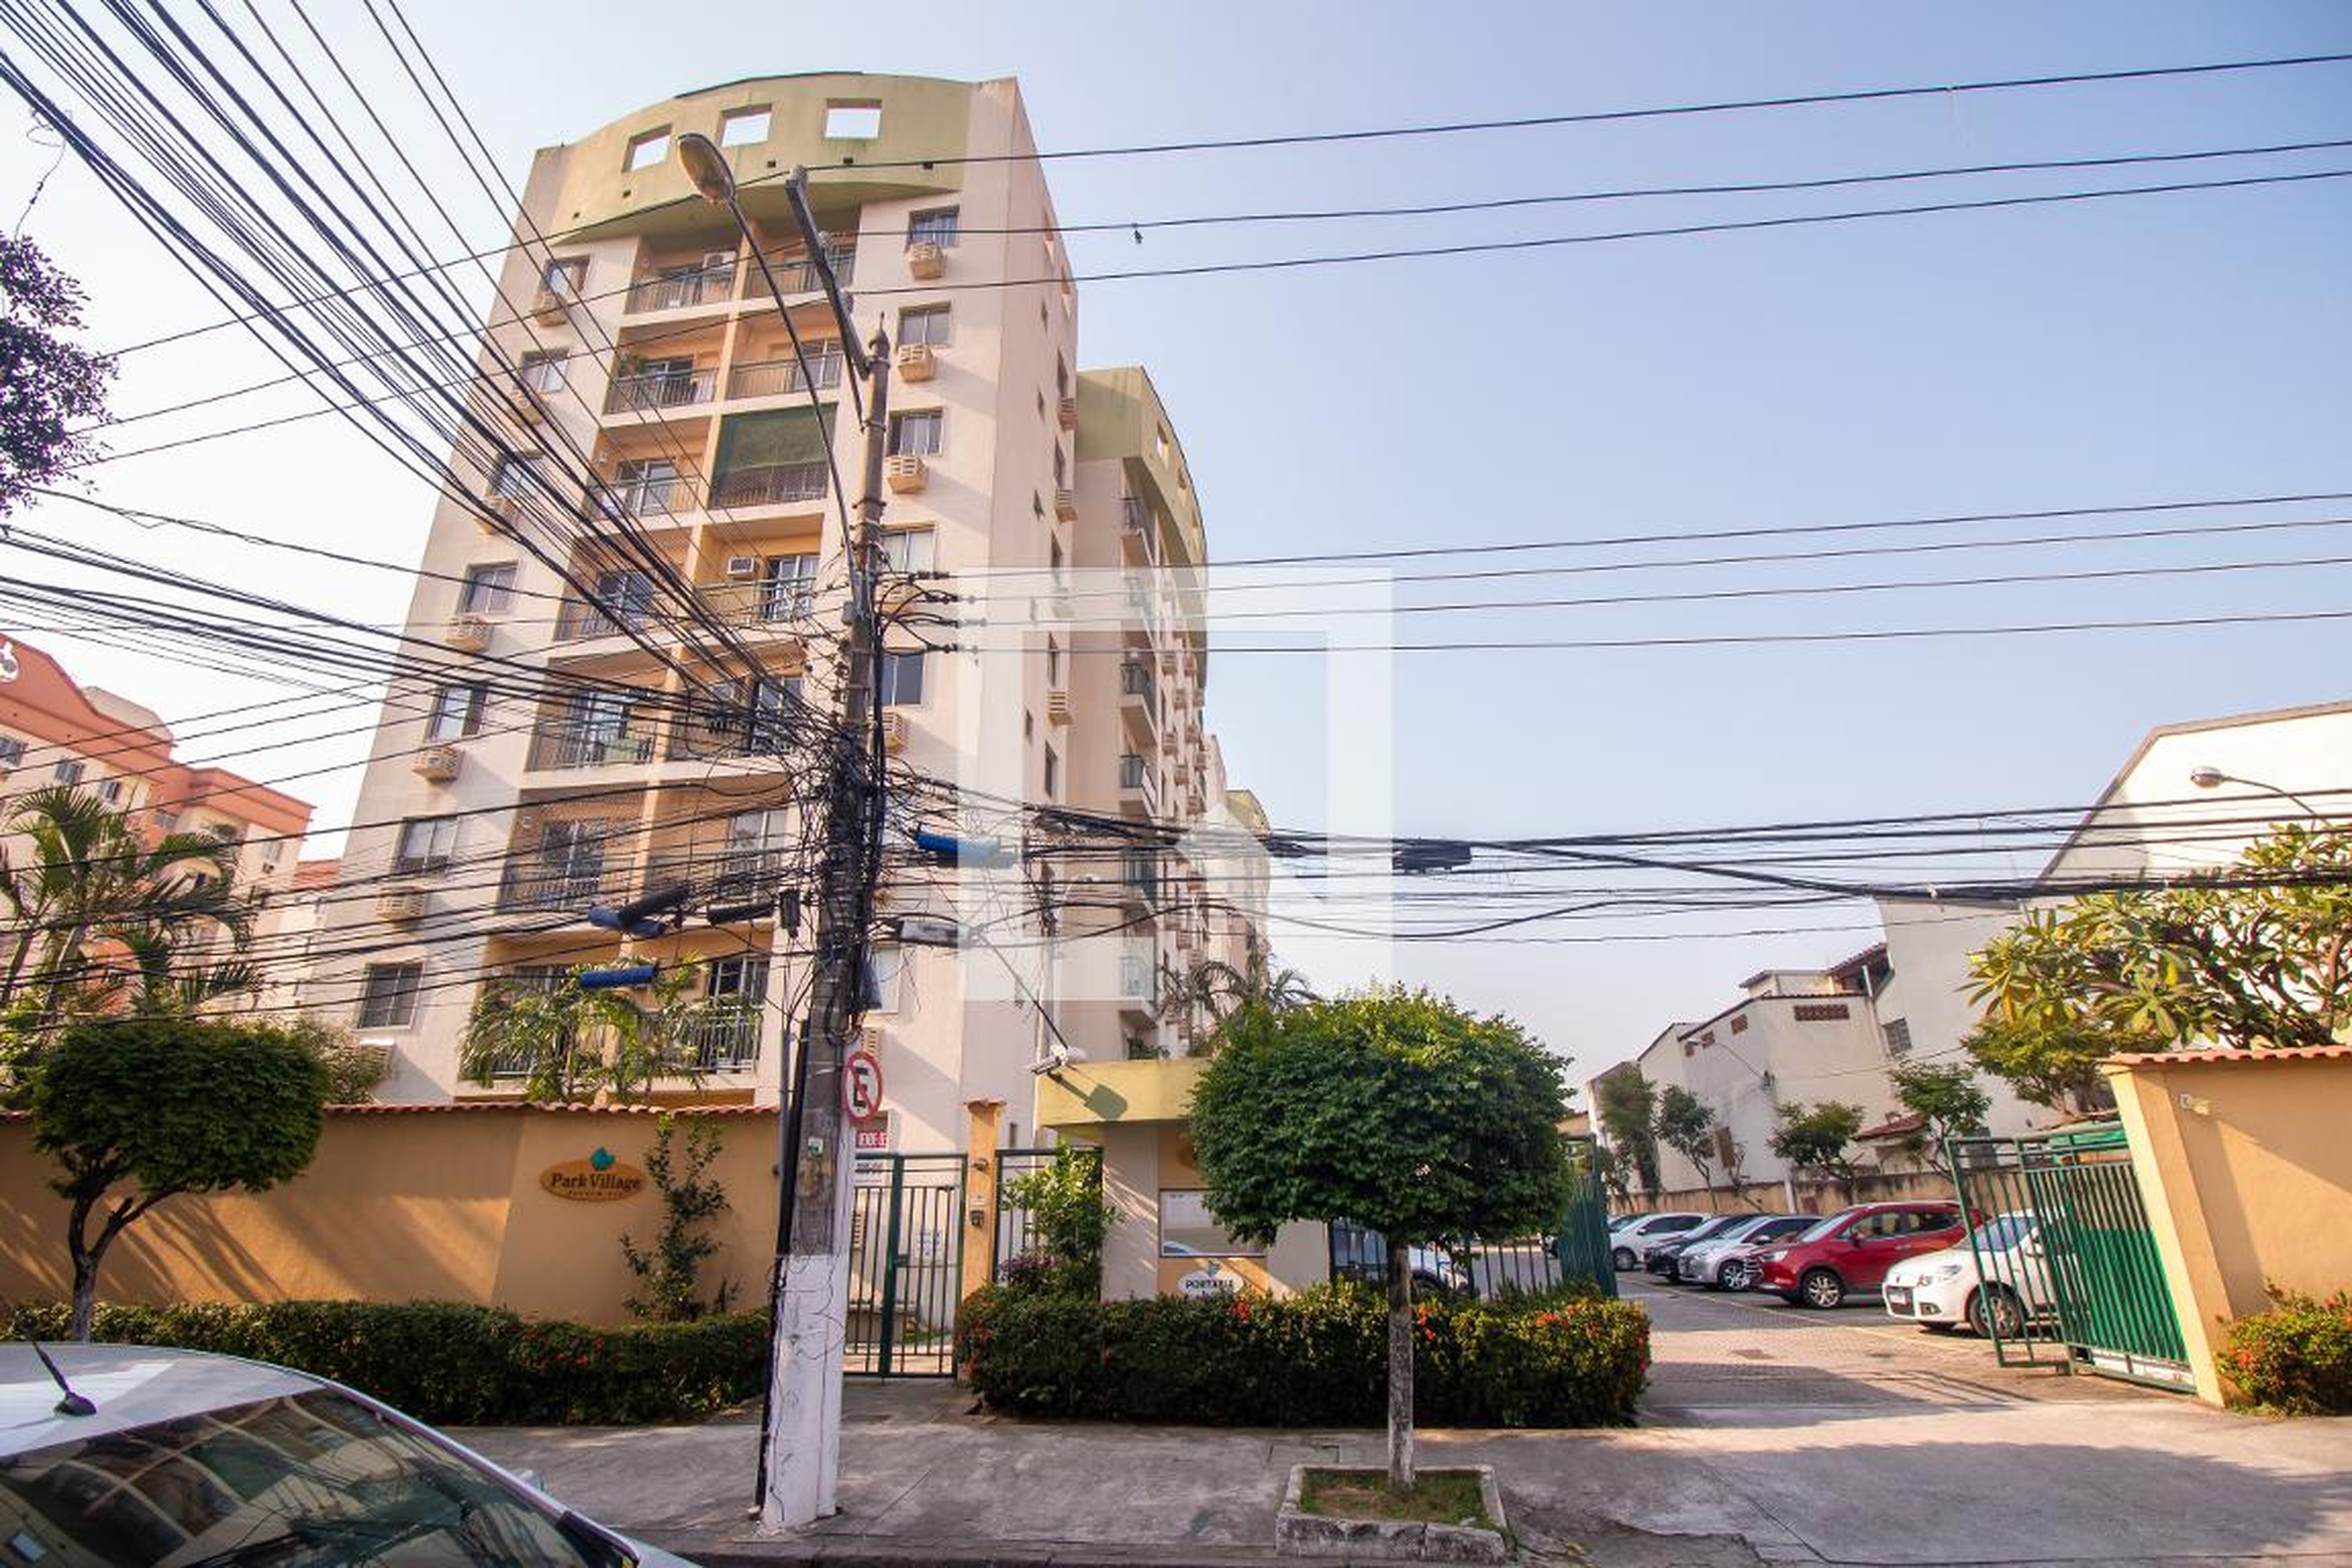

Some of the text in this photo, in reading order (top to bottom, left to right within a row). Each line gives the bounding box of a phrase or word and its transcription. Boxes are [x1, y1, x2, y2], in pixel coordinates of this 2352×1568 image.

[853, 1067, 869, 1109] E
[552, 1173, 641, 1192] Park Village
